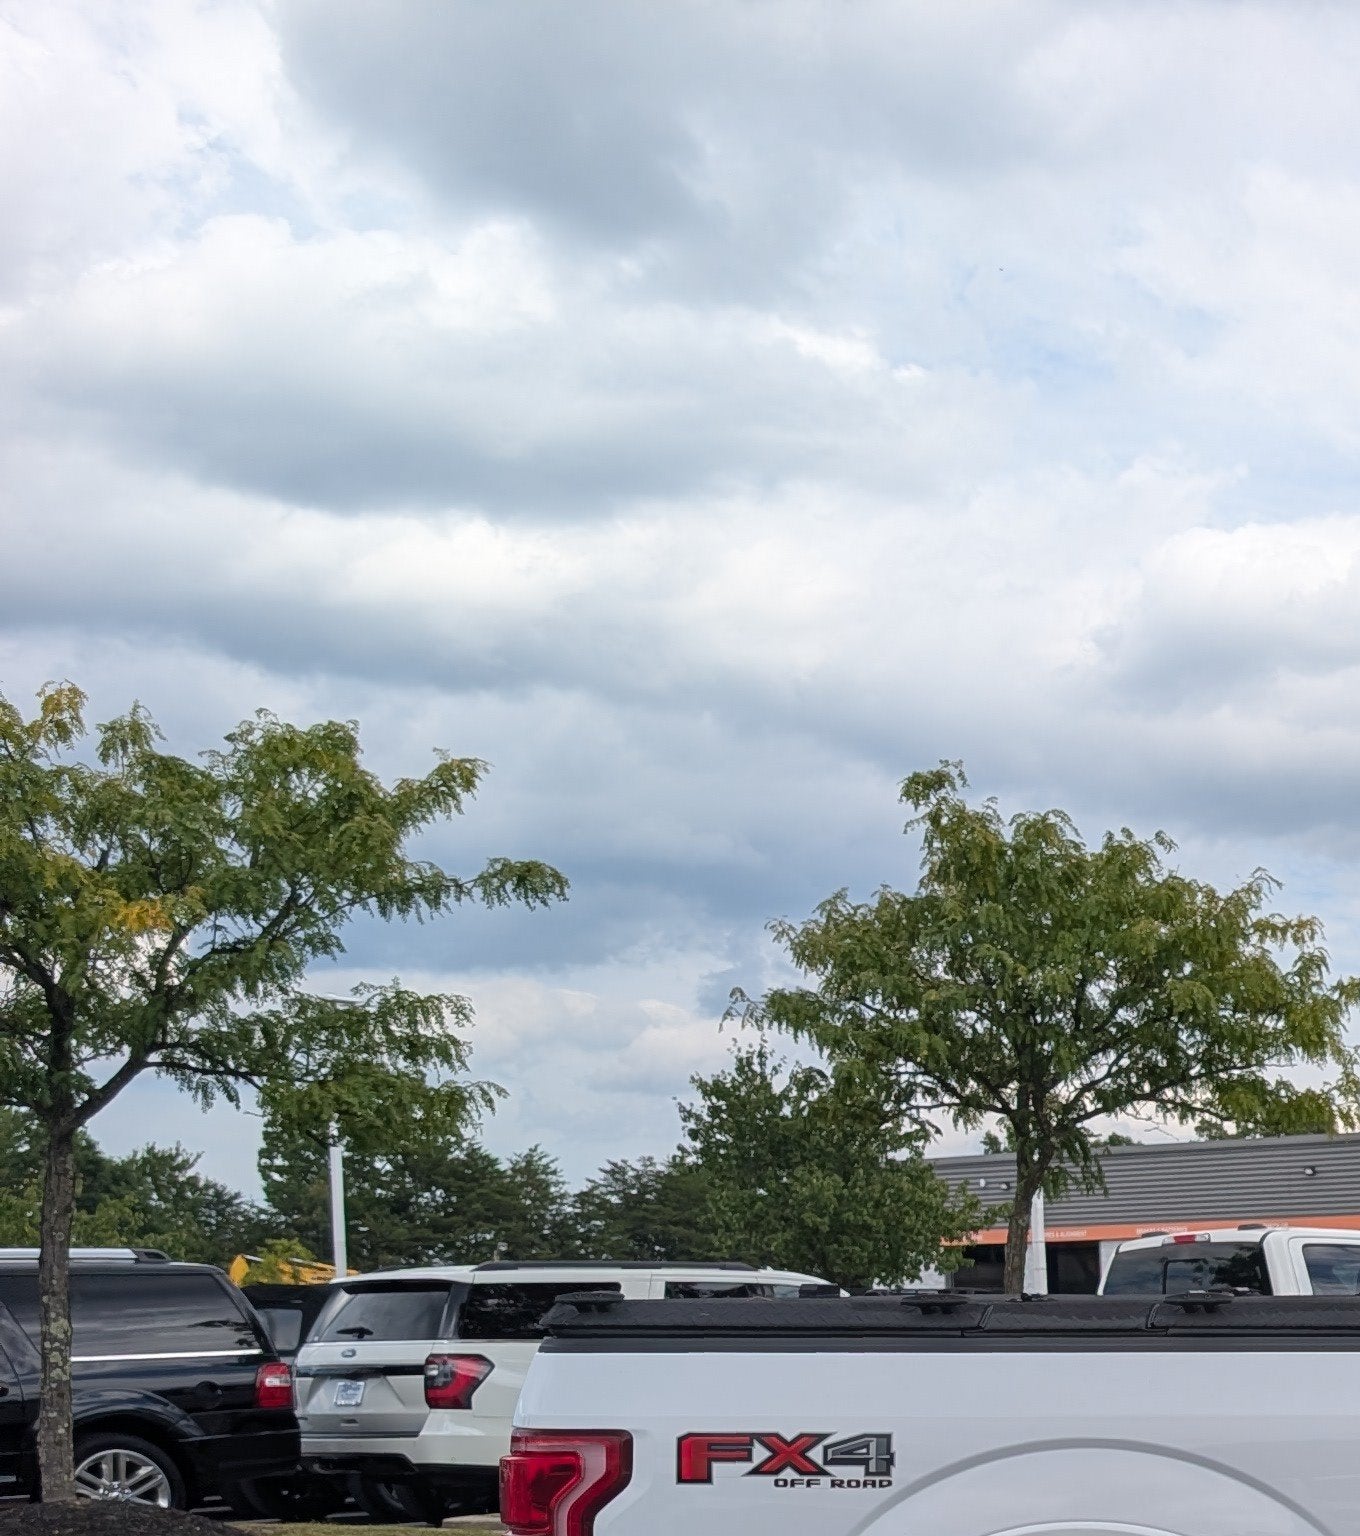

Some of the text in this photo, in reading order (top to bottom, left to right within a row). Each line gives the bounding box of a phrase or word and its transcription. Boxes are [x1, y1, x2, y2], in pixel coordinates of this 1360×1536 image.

[676, 1432, 895, 1484] FX4
[774, 1478, 893, 1489] OFF ROAD
